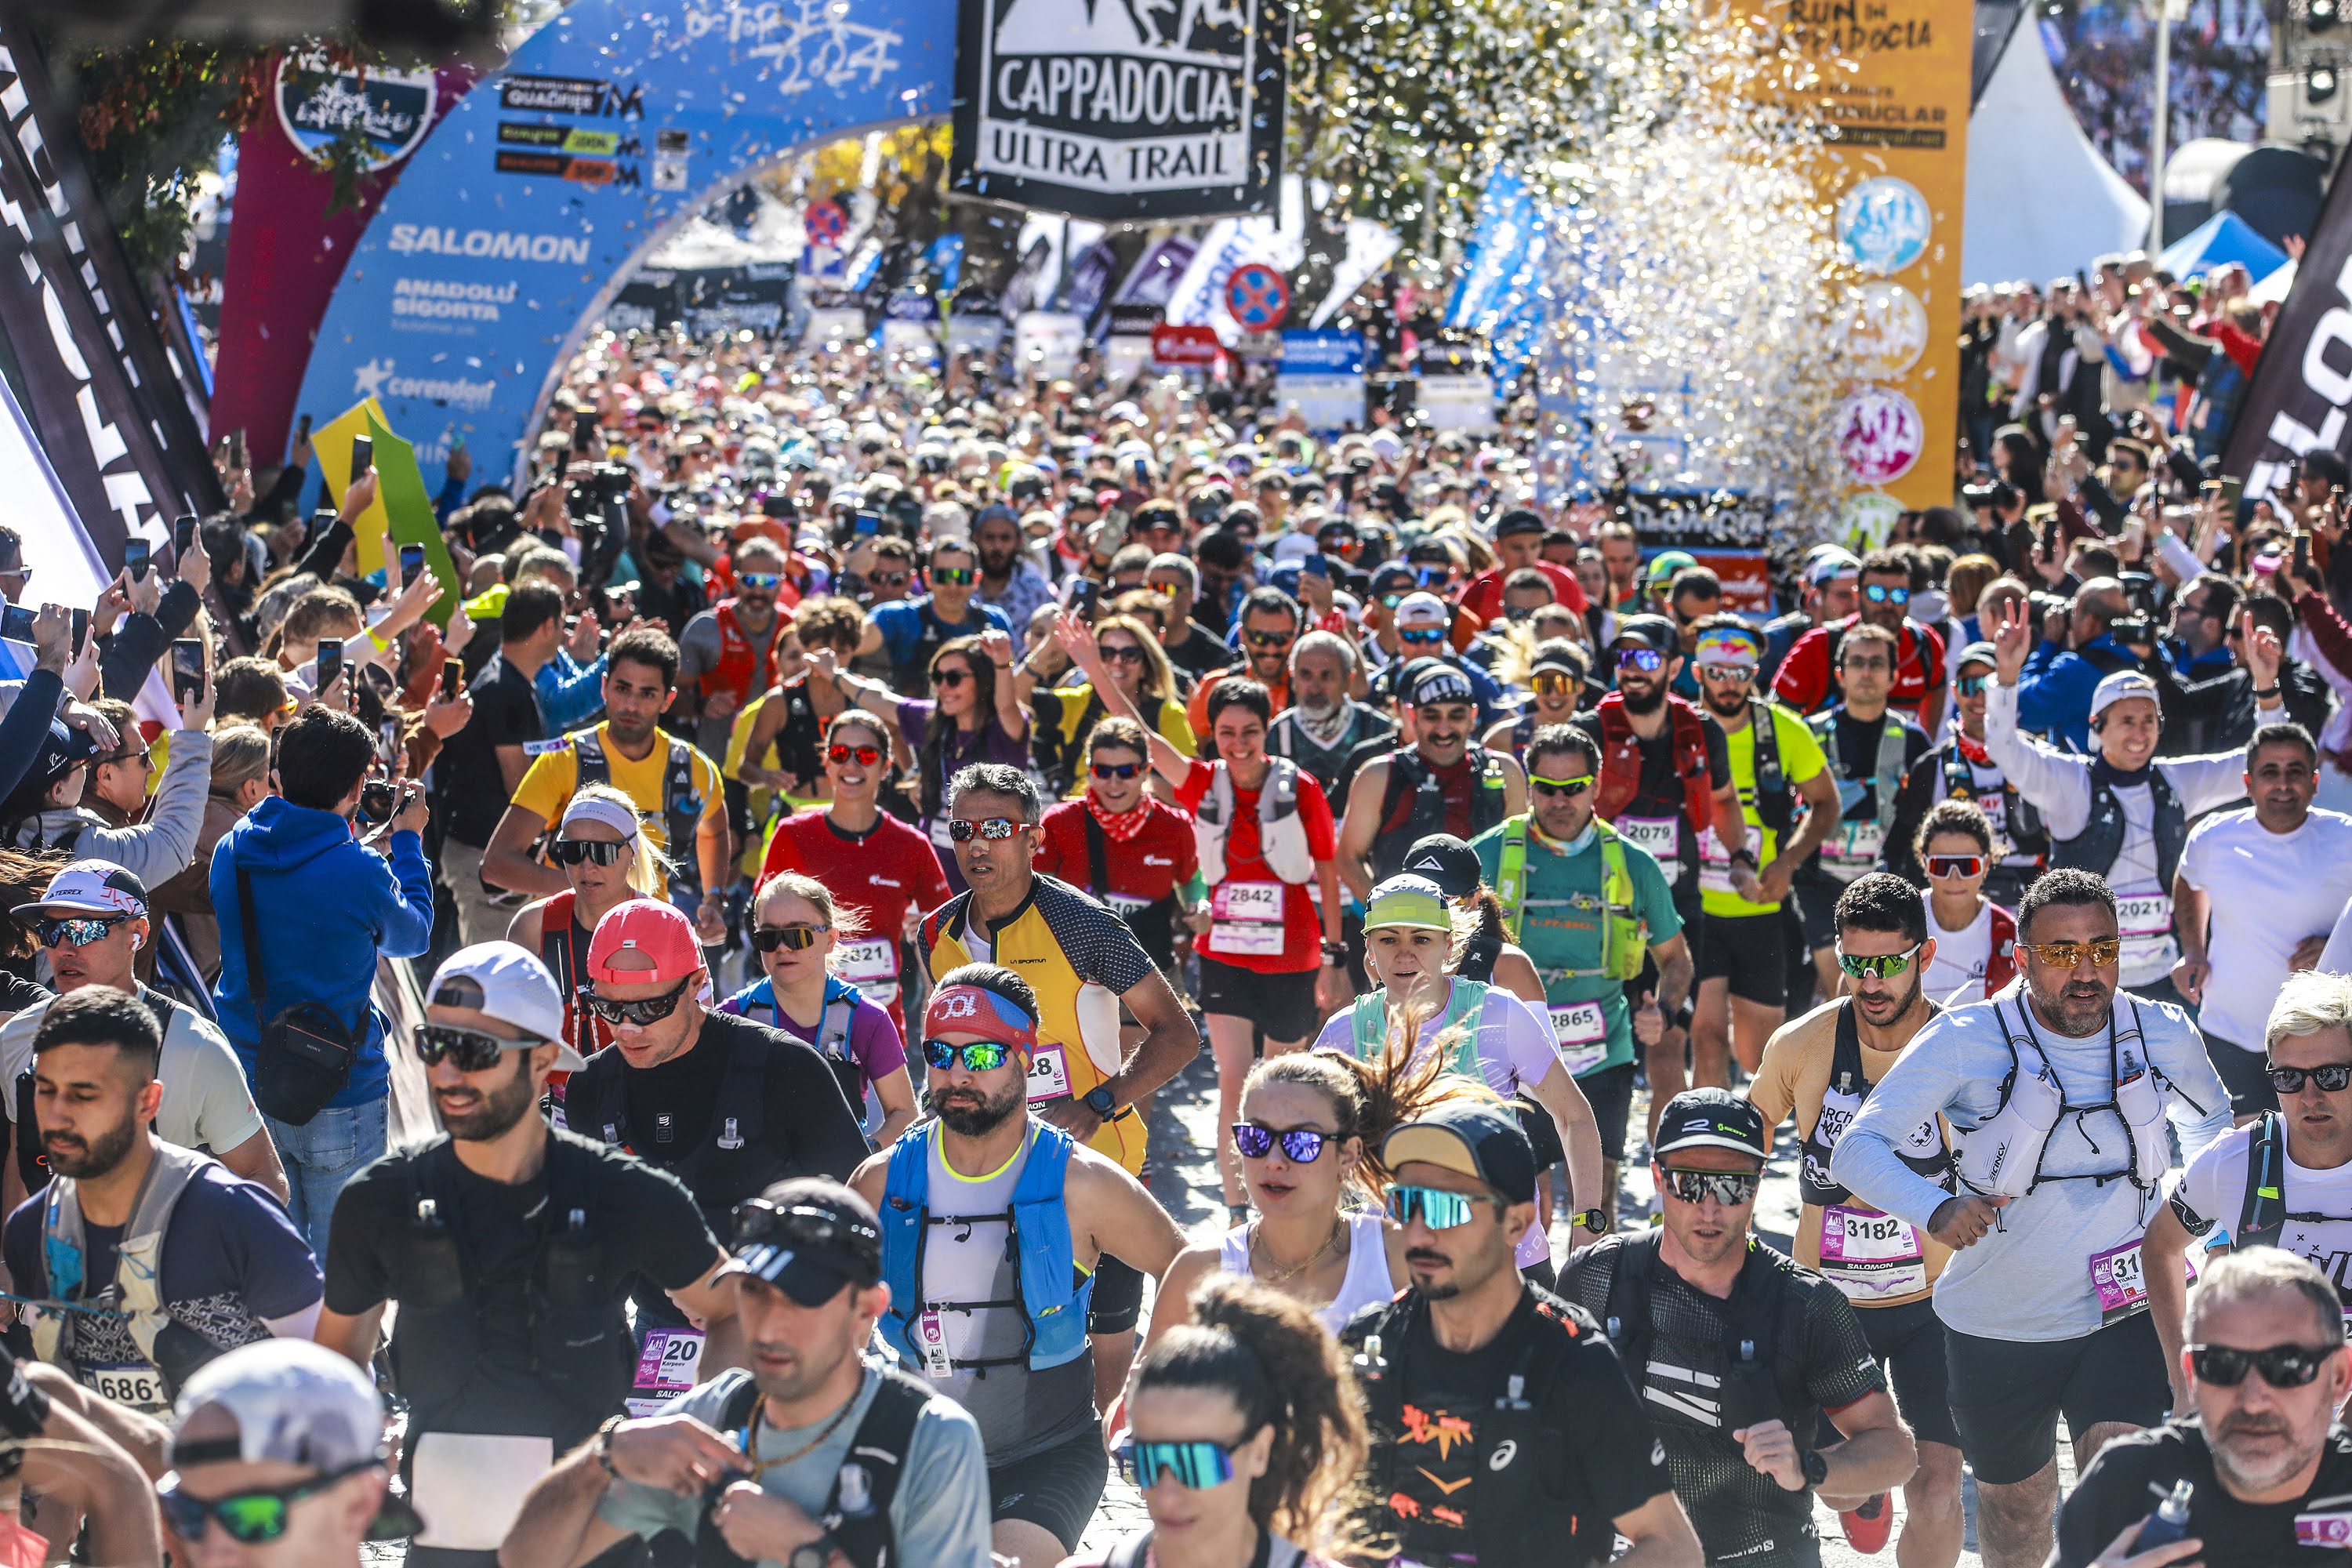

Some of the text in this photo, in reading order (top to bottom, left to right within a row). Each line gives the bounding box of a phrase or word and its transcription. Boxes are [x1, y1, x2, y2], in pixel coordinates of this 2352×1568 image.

[997, 56, 1236, 125] CAPPADOCIA
[993, 129, 1231, 182] ULTRA TRAIL
[387, 223, 590, 265] SALOMON
[1628, 824, 1671, 840] 2079
[1229, 888, 1273, 903] 2842
[2119, 901, 2161, 916] 2021
[1550, 1009, 1593, 1027] 2865
[1846, 1219, 1900, 1240] 3182
[1846, 1261, 1893, 1271] SALOMON
[2114, 1253, 2142, 1278] 31
[2117, 1274, 2138, 1283] YILMAZ
[663, 1340, 698, 1361] 20
